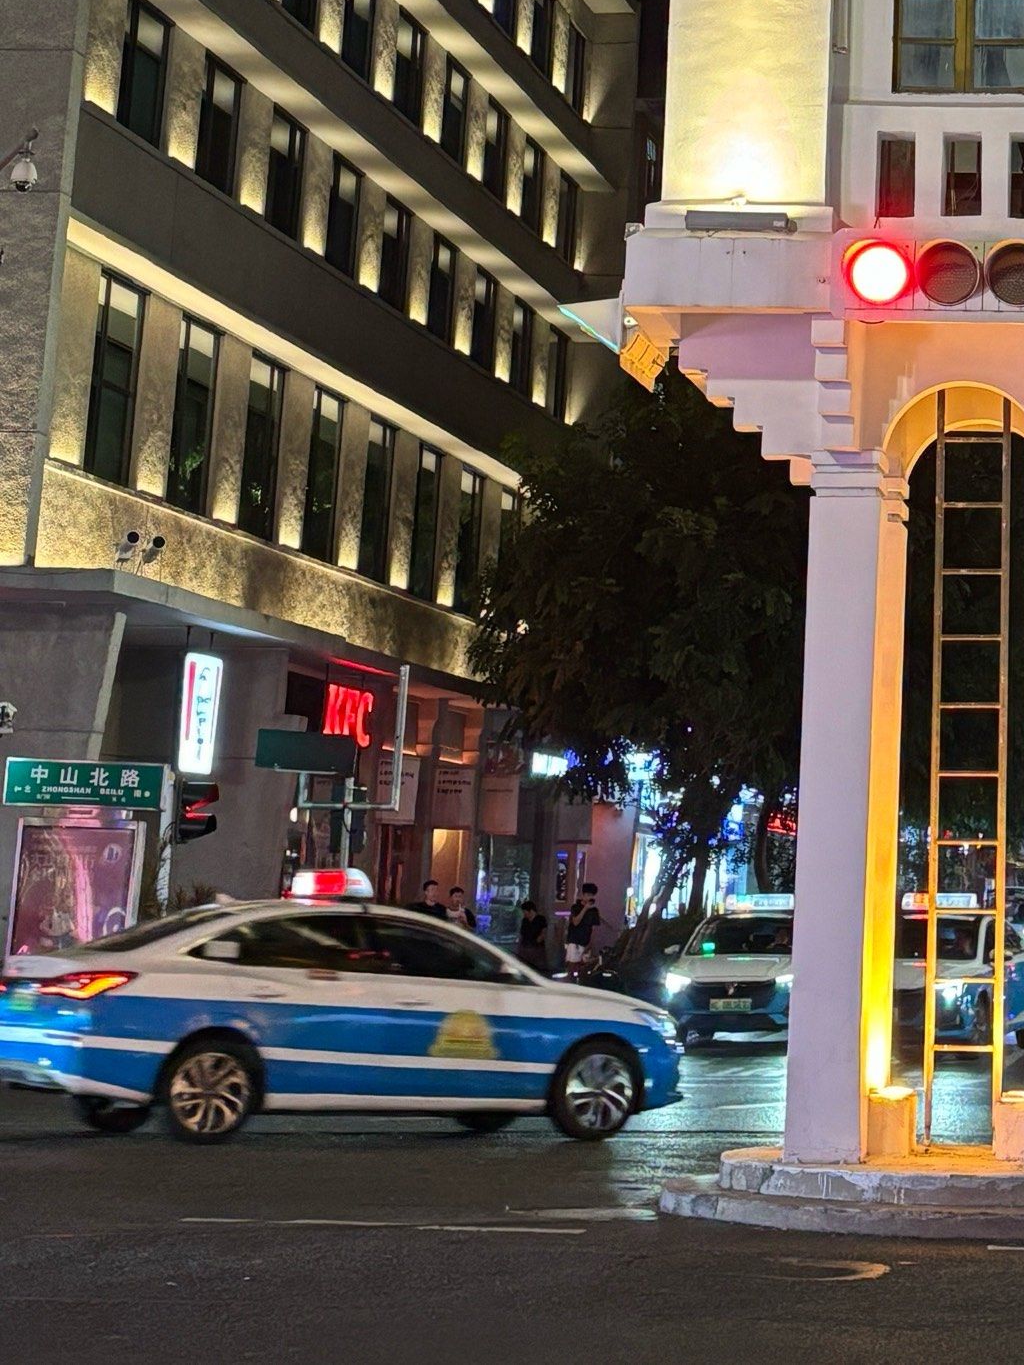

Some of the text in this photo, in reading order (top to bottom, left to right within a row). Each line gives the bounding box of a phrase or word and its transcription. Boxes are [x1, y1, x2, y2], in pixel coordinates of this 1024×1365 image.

[322, 683, 375, 748] KFC
[30, 764, 141, 788] 中山北路
[41, 785, 92, 795] ZHONGSHAN
